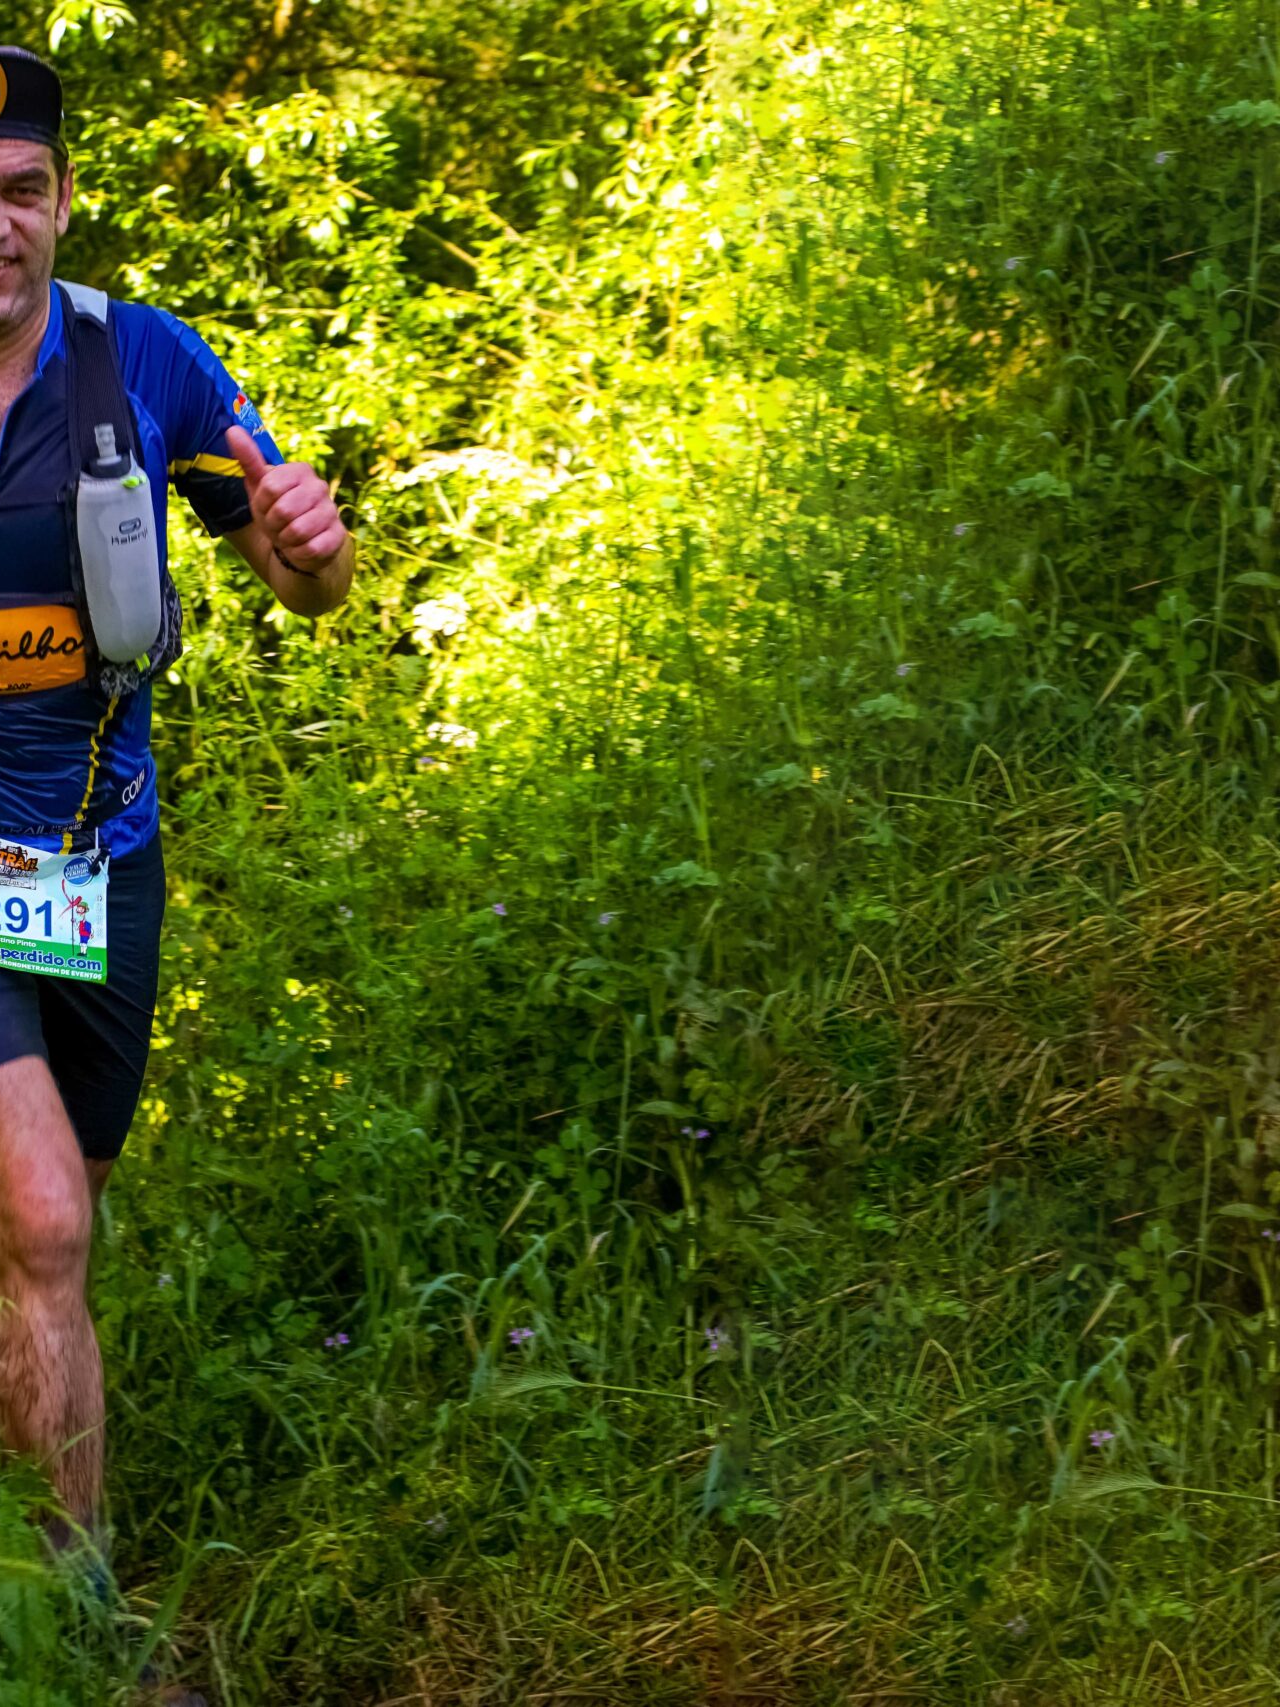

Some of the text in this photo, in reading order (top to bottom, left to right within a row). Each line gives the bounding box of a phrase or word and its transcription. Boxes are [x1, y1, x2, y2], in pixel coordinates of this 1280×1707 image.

[17, 938, 37, 948] Pinto
[0, 959, 60, 974] CRONOMETRAGEM
[71, 970, 103, 980] EVENTOS
